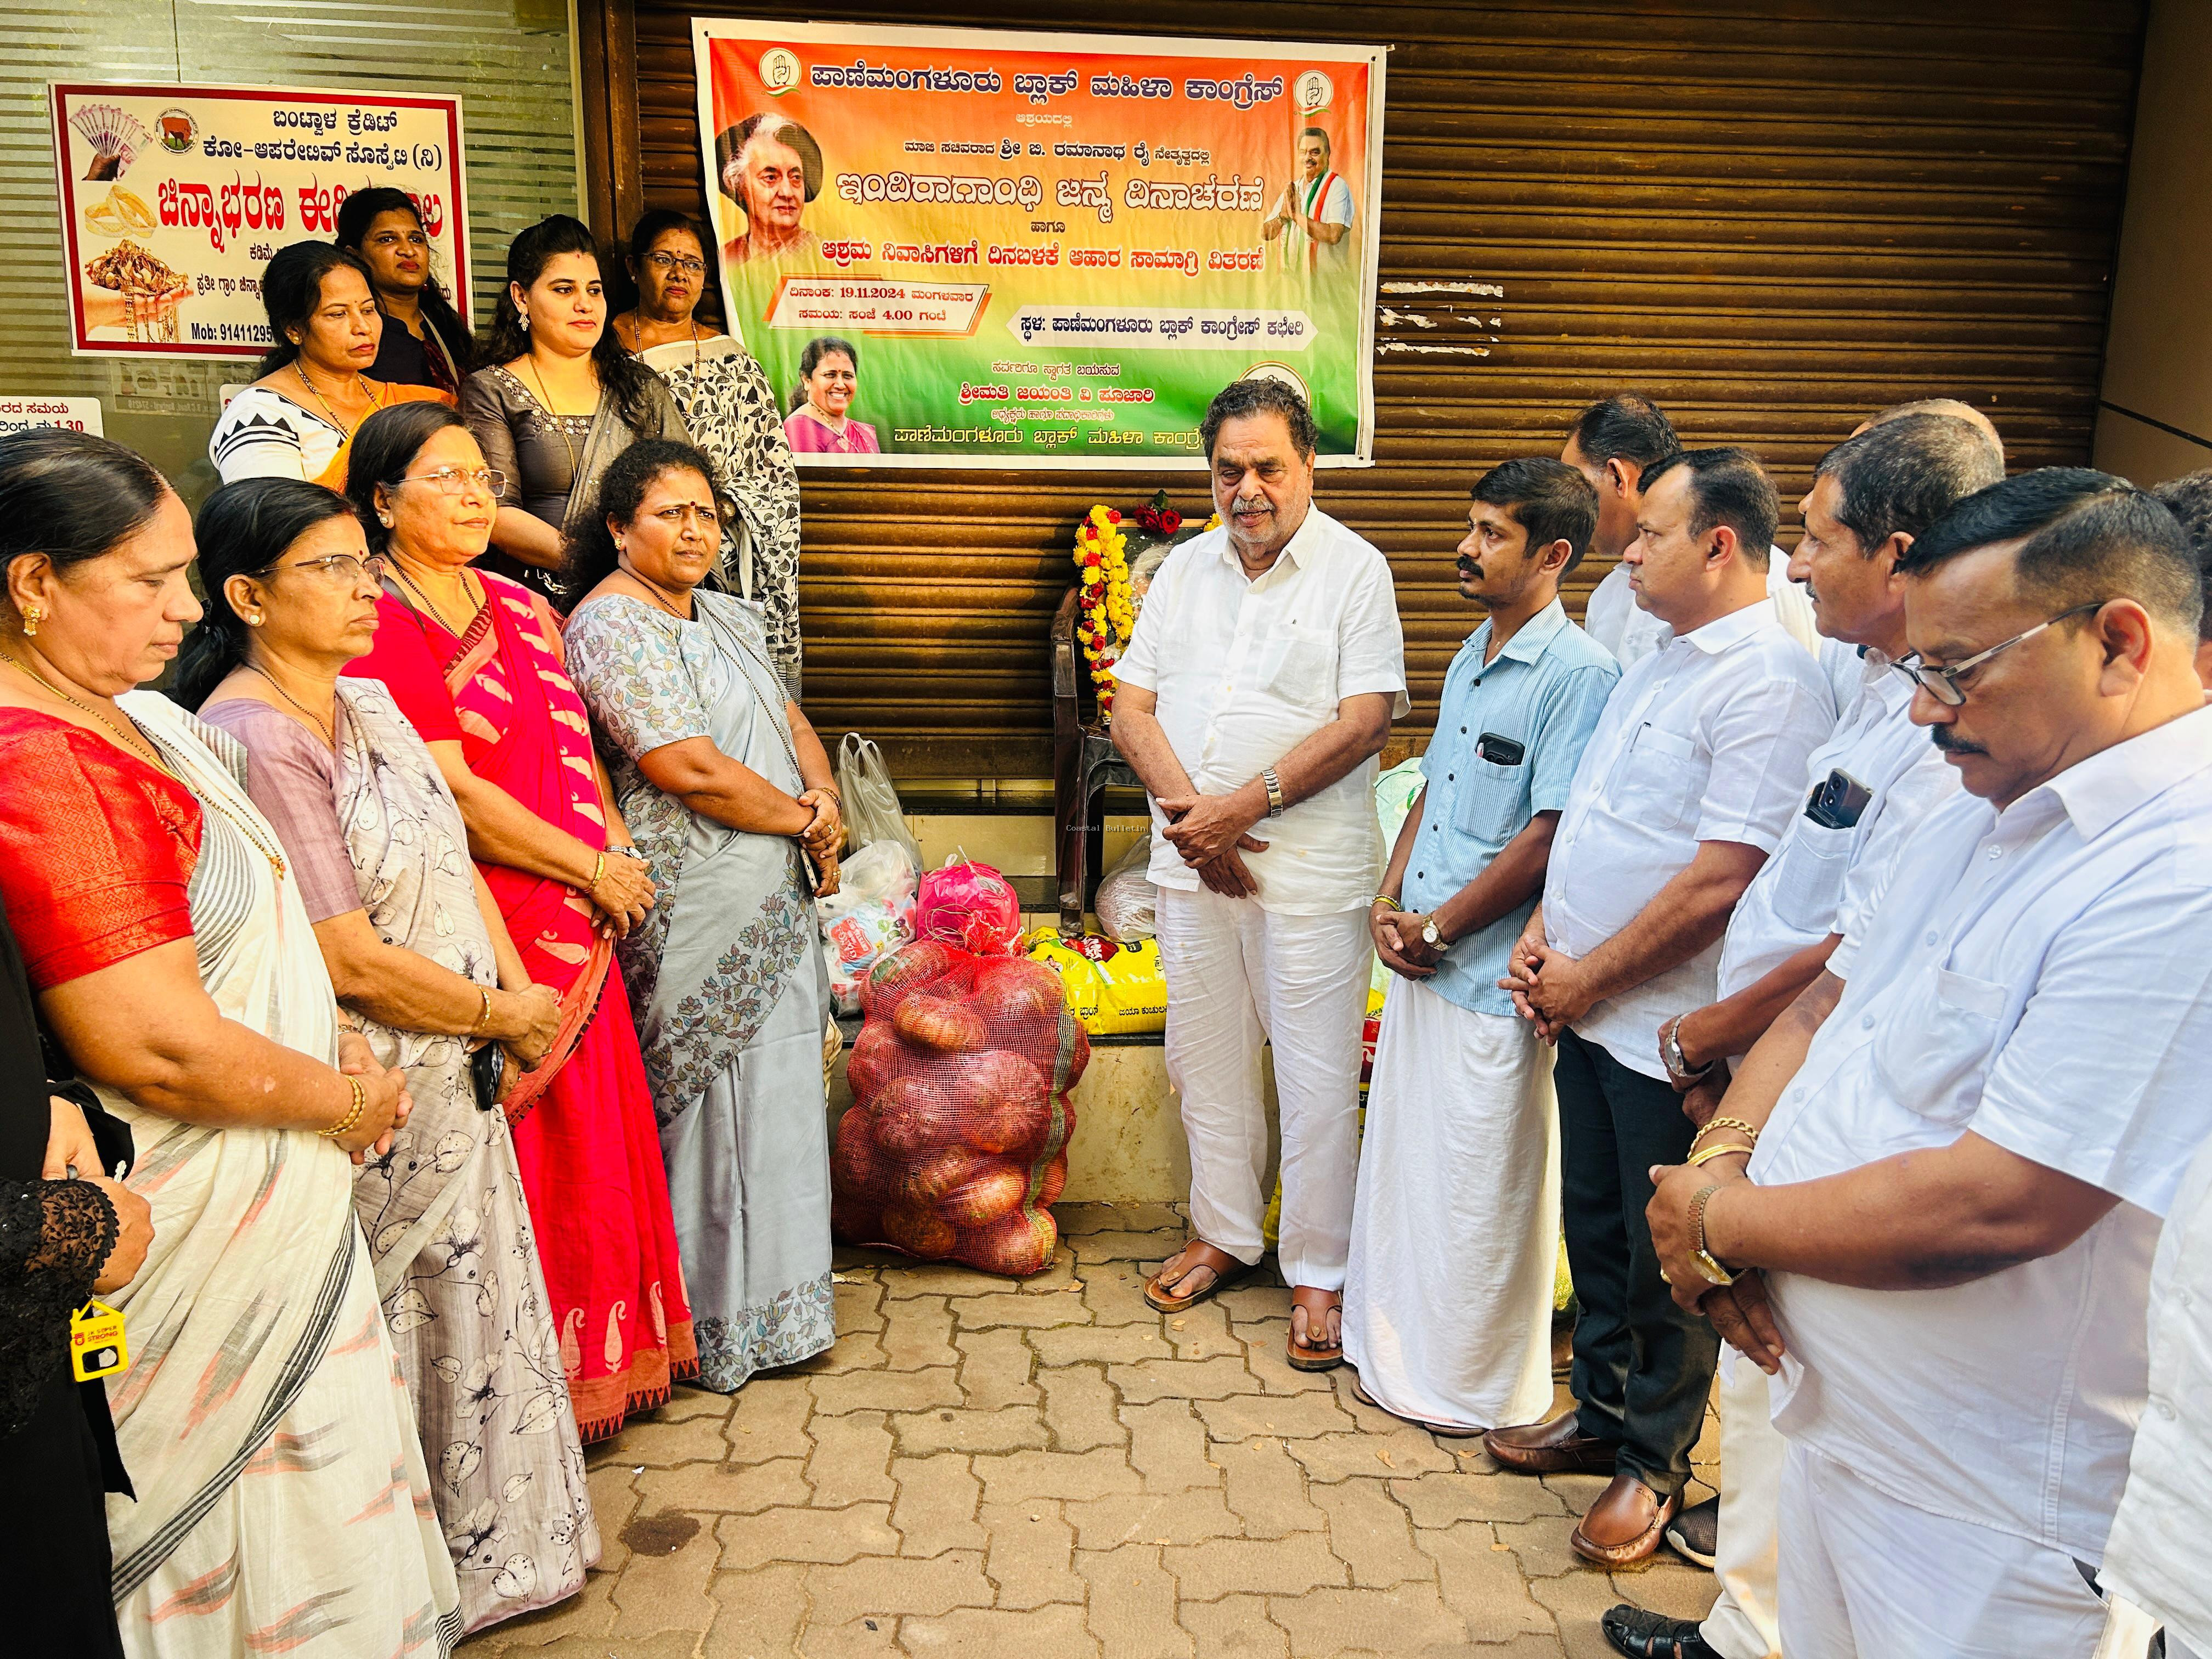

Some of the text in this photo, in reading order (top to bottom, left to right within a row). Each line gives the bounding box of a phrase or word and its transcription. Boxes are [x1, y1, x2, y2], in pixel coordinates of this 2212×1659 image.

[812, 61, 1282, 109] ಪಾಣೆಮಂಗಳೂರು ಬ್ಲಾಕ್ ಮಹಿಳಾ ಕಾಂಗ್ರೆಸ್
[273, 108, 397, 136] ಬಂಟ್ವಾಳ ಕ್ರೆಡಿಟ್
[1015, 112, 1072, 128] ಆಶ್ರಯದಲ್ಲಿ
[203, 135, 341, 162] ಕೋ-ಆಪರೇಟಿವ್
[413, 143, 442, 171] (ನಿ)
[905, 141, 935, 153] ಮಾಜಿ
[941, 141, 995, 154] ಸಚಿವರಾದ
[1000, 139, 1020, 159] ಶ್ರೀ
[1029, 143, 1046, 156] ಬಿ.
[1054, 142, 1125, 161] ರಮಾನಾಥ
[1133, 142, 1149, 165] ರೈ
[836, 171, 1264, 223] ಇಂದಿರಾಗಾಂಧಿ ಜನ್ಮ ದಿನಾಚರಣೆ
[159, 170, 284, 253] ಚಿನ್ನಾಭರಣ
[1030, 221, 1065, 233] ಹಾಗೂ
[250, 242, 273, 261] ಕಡಿಮೆ
[822, 241, 872, 267] ಆಶ್ರಮ
[882, 240, 978, 264] ನಿವಾಸಿಗಳಿಗೆ
[988, 242, 1059, 266] ದಿನಬಳಕೆ
[1069, 247, 1121, 267] ಆಹಾರ
[1208, 247, 1263, 271] ವಿತರಣೆ
[789, 286, 973, 302] ದಿನಾಂಕ: 19.11.2024 ಮಂಗಳವಾರ
[798, 309, 842, 319] ಸಮಯ:
[882, 310, 913, 320] 4.00
[919, 309, 946, 321] ಗಂಟೆ
[191, 323, 273, 343] Mob: 91411295
[1021, 315, 1046, 342] ಸ್ಥಳ:
[1052, 312, 1153, 334] ಪಾಣೆಮಂಗಳೂರು
[1160, 315, 1193, 340] ಬ್ಲಾಕ್
[1267, 316, 1304, 338] ಕಛೇರಿ
[992, 360, 1120, 381] ಸರ್ವರಿಗೂ ಸ್ವಾಗತ ಬಯಸುವ
[960, 382, 1154, 404] ಶ್ರೀಮತಿ ಜಯಂತಿ ವಿ ಪೂಜಾರಿ
[26, 402, 69, 414] ಸಮಯ
[894, 424, 1205, 450] ಪಾಣೆಮಂಗಳೂರು ಬ್ಲಾಕ್ ಮಹಿಳಾ ಕಾಂಗ್ರೆ
[87, 1331, 119, 1342] STRONG
